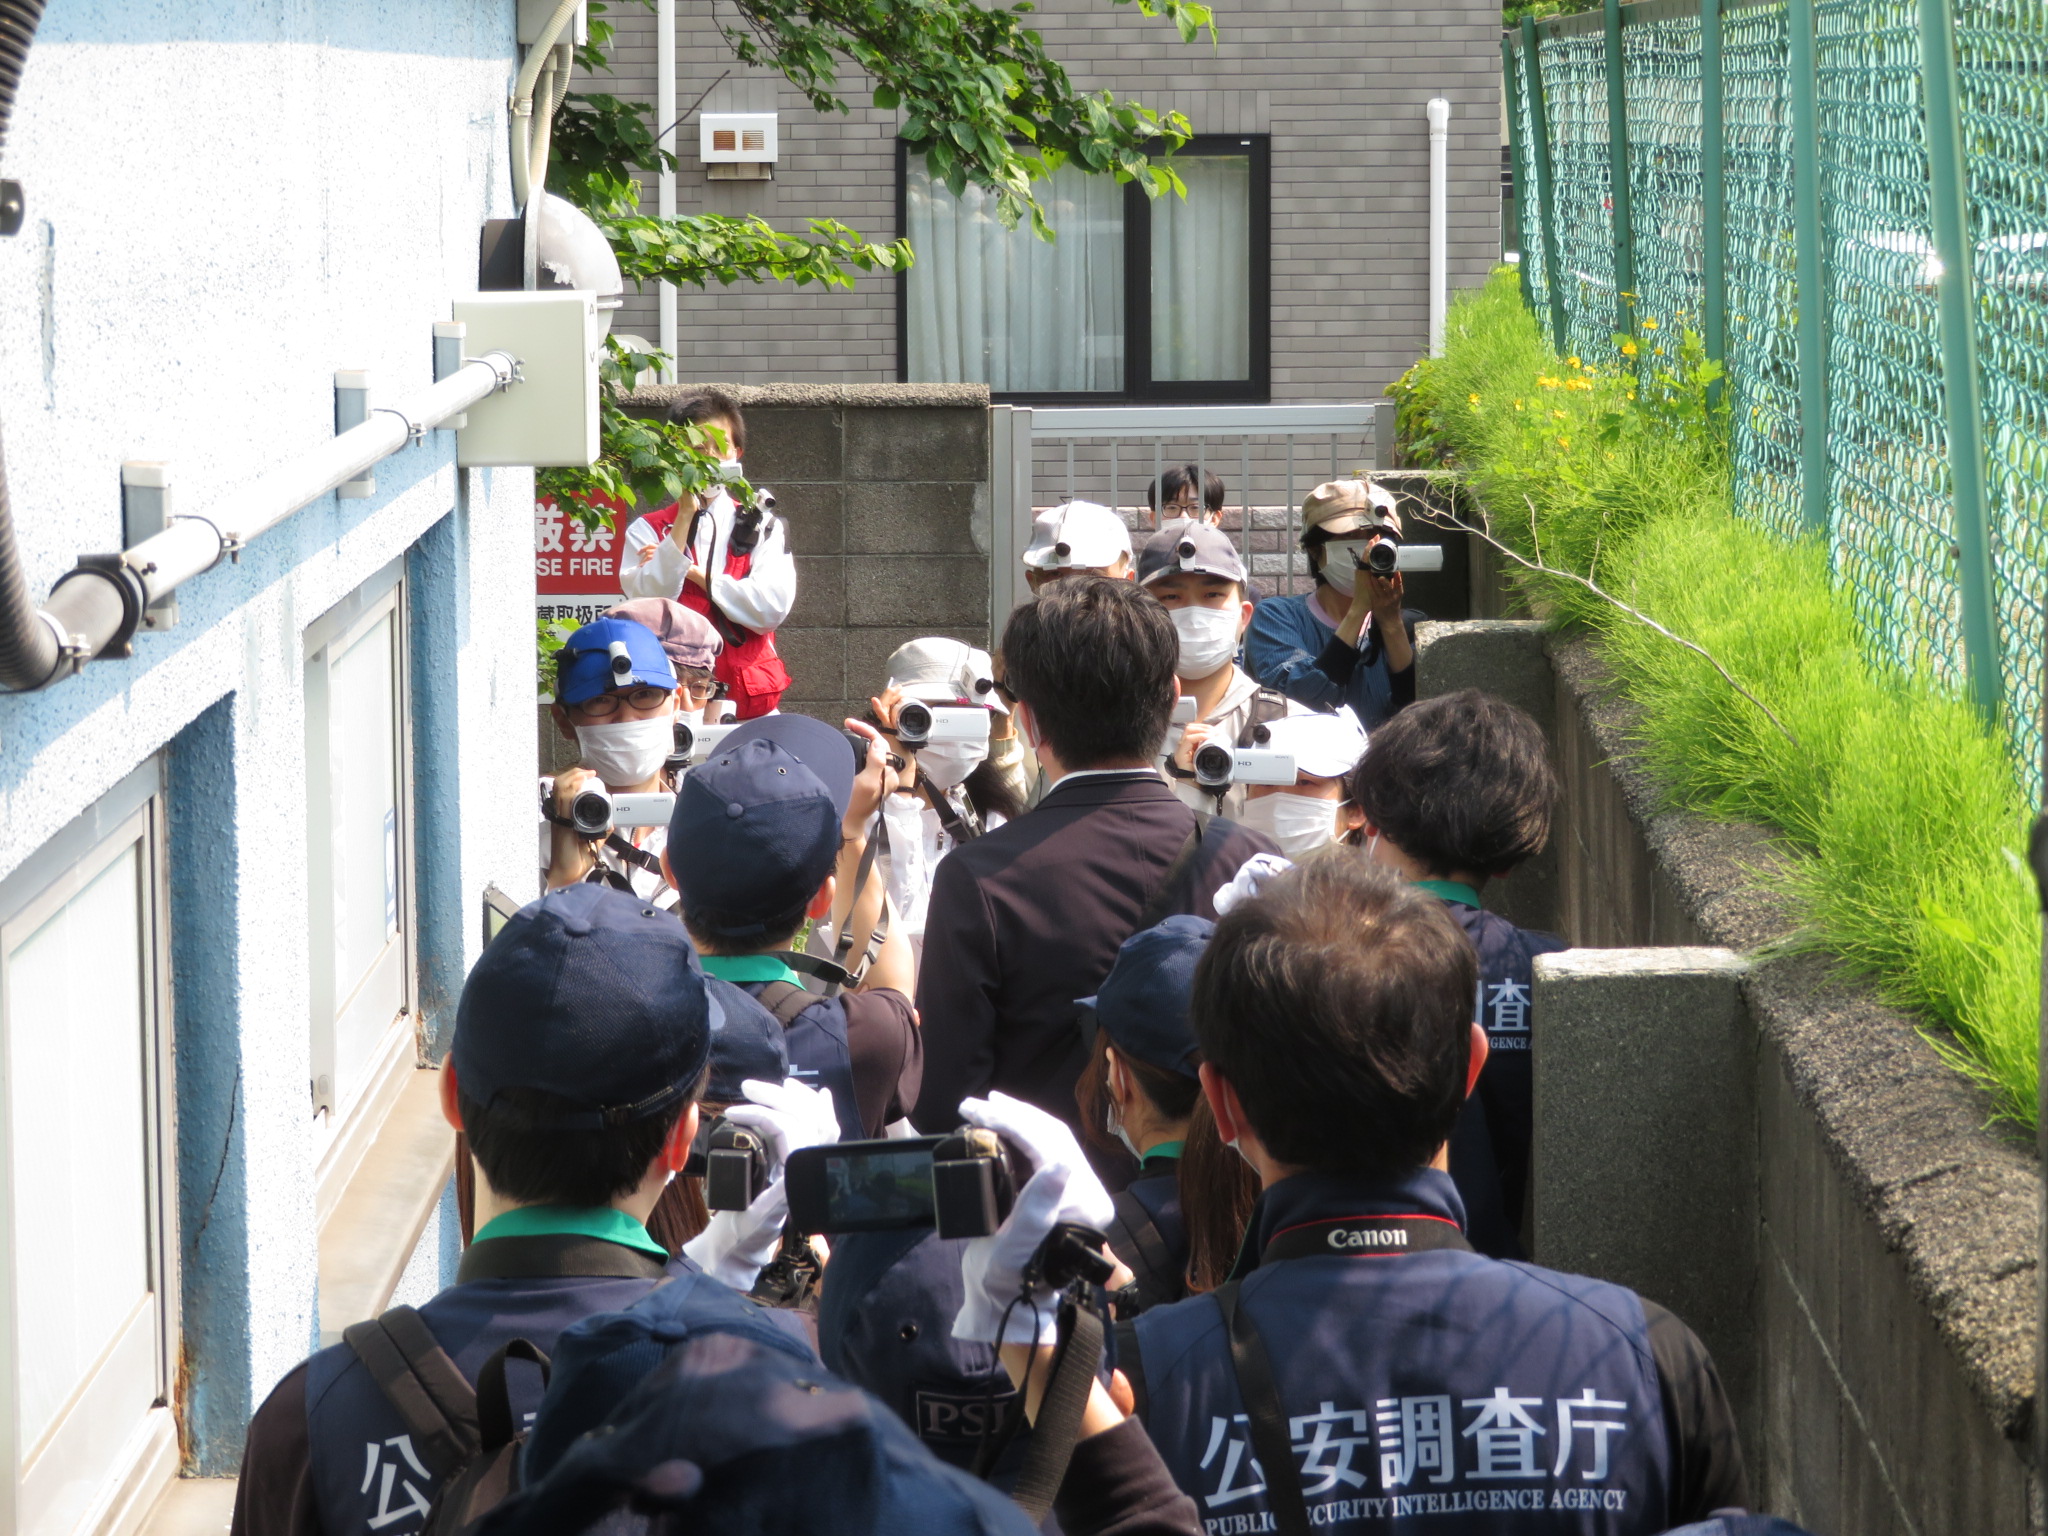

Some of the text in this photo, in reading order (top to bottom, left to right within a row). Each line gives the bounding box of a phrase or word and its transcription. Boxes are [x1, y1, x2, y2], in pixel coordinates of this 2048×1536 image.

[569, 558, 614, 576] FIRE
[1475, 977, 1531, 1031] 査
[1327, 1228, 1408, 1249] Canon
[1200, 1387, 1627, 1507] 公安調査庁
[1392, 1489, 1545, 1517] INTELLIGENCE
[1550, 1488, 1627, 1510] AGENCY
